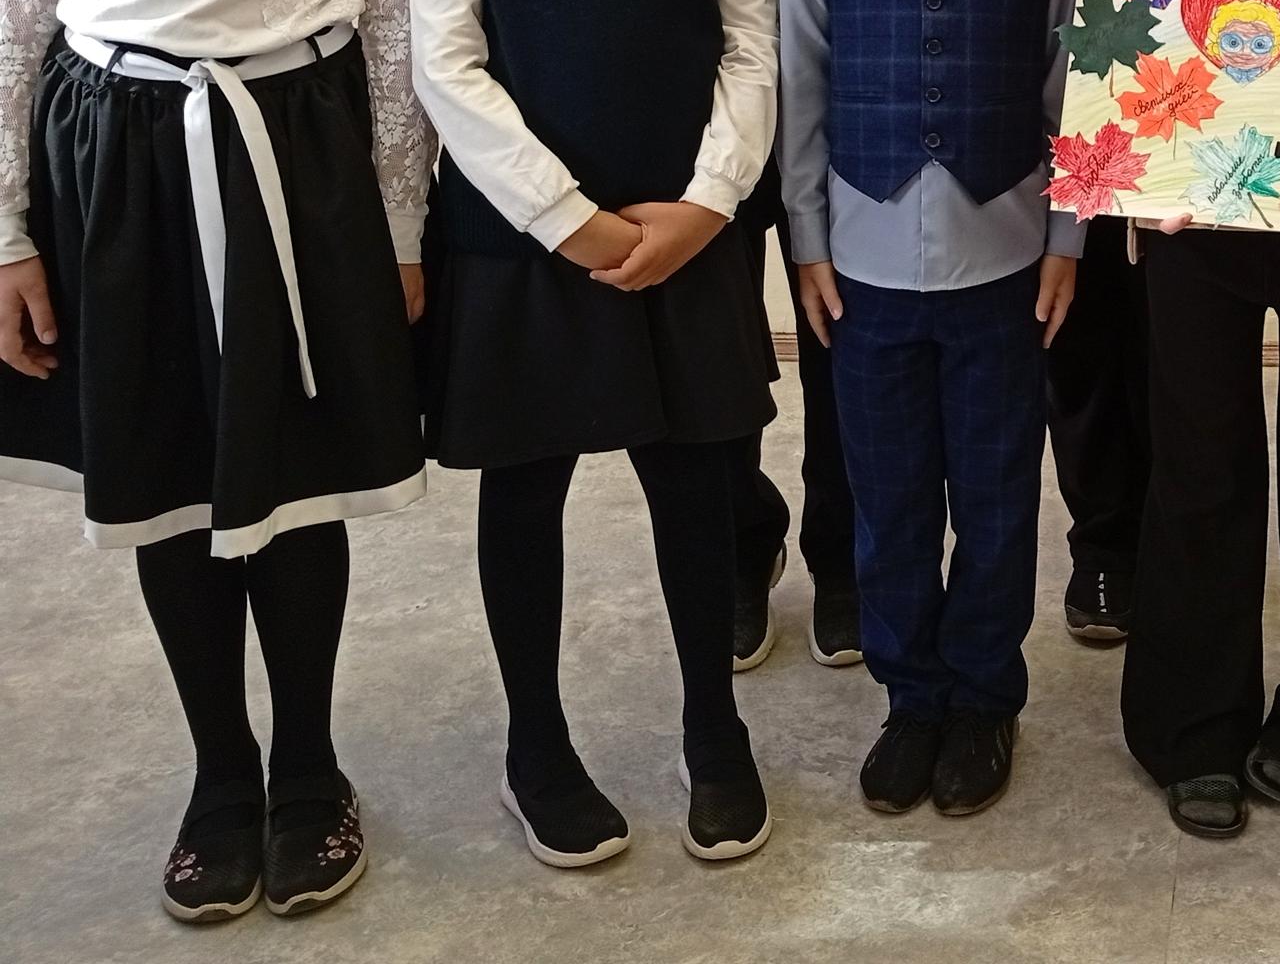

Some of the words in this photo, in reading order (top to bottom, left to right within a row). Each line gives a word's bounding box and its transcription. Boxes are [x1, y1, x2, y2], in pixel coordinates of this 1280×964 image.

[1134, 82, 1187, 116] светлых
[1168, 84, 1199, 117] дней
[1232, 154, 1265, 199] заботы
